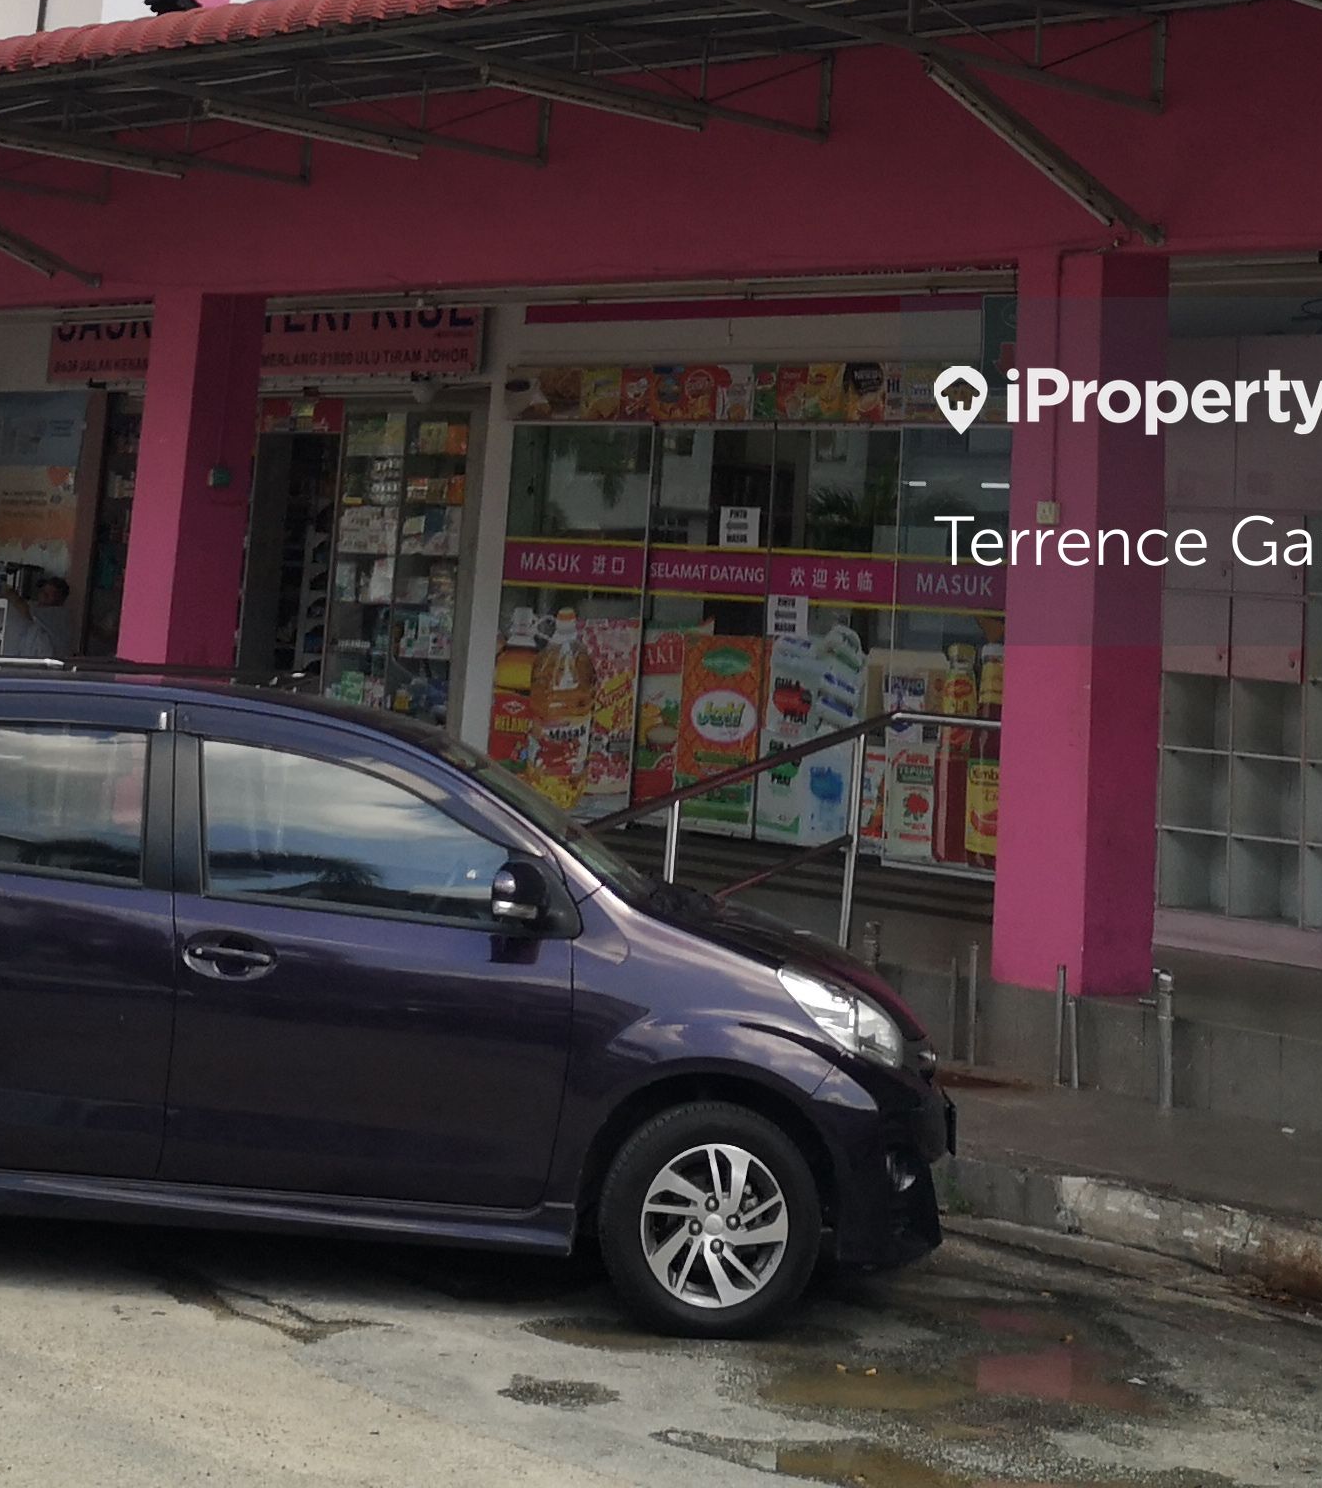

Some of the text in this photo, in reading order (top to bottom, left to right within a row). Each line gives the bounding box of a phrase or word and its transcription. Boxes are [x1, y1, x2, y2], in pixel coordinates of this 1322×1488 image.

[519, 551, 581, 575] MASUK
[650, 562, 765, 584] SELAMAT DATANG
[789, 567, 874, 593] 欢迎光临
[915, 572, 993, 597] MASUK
